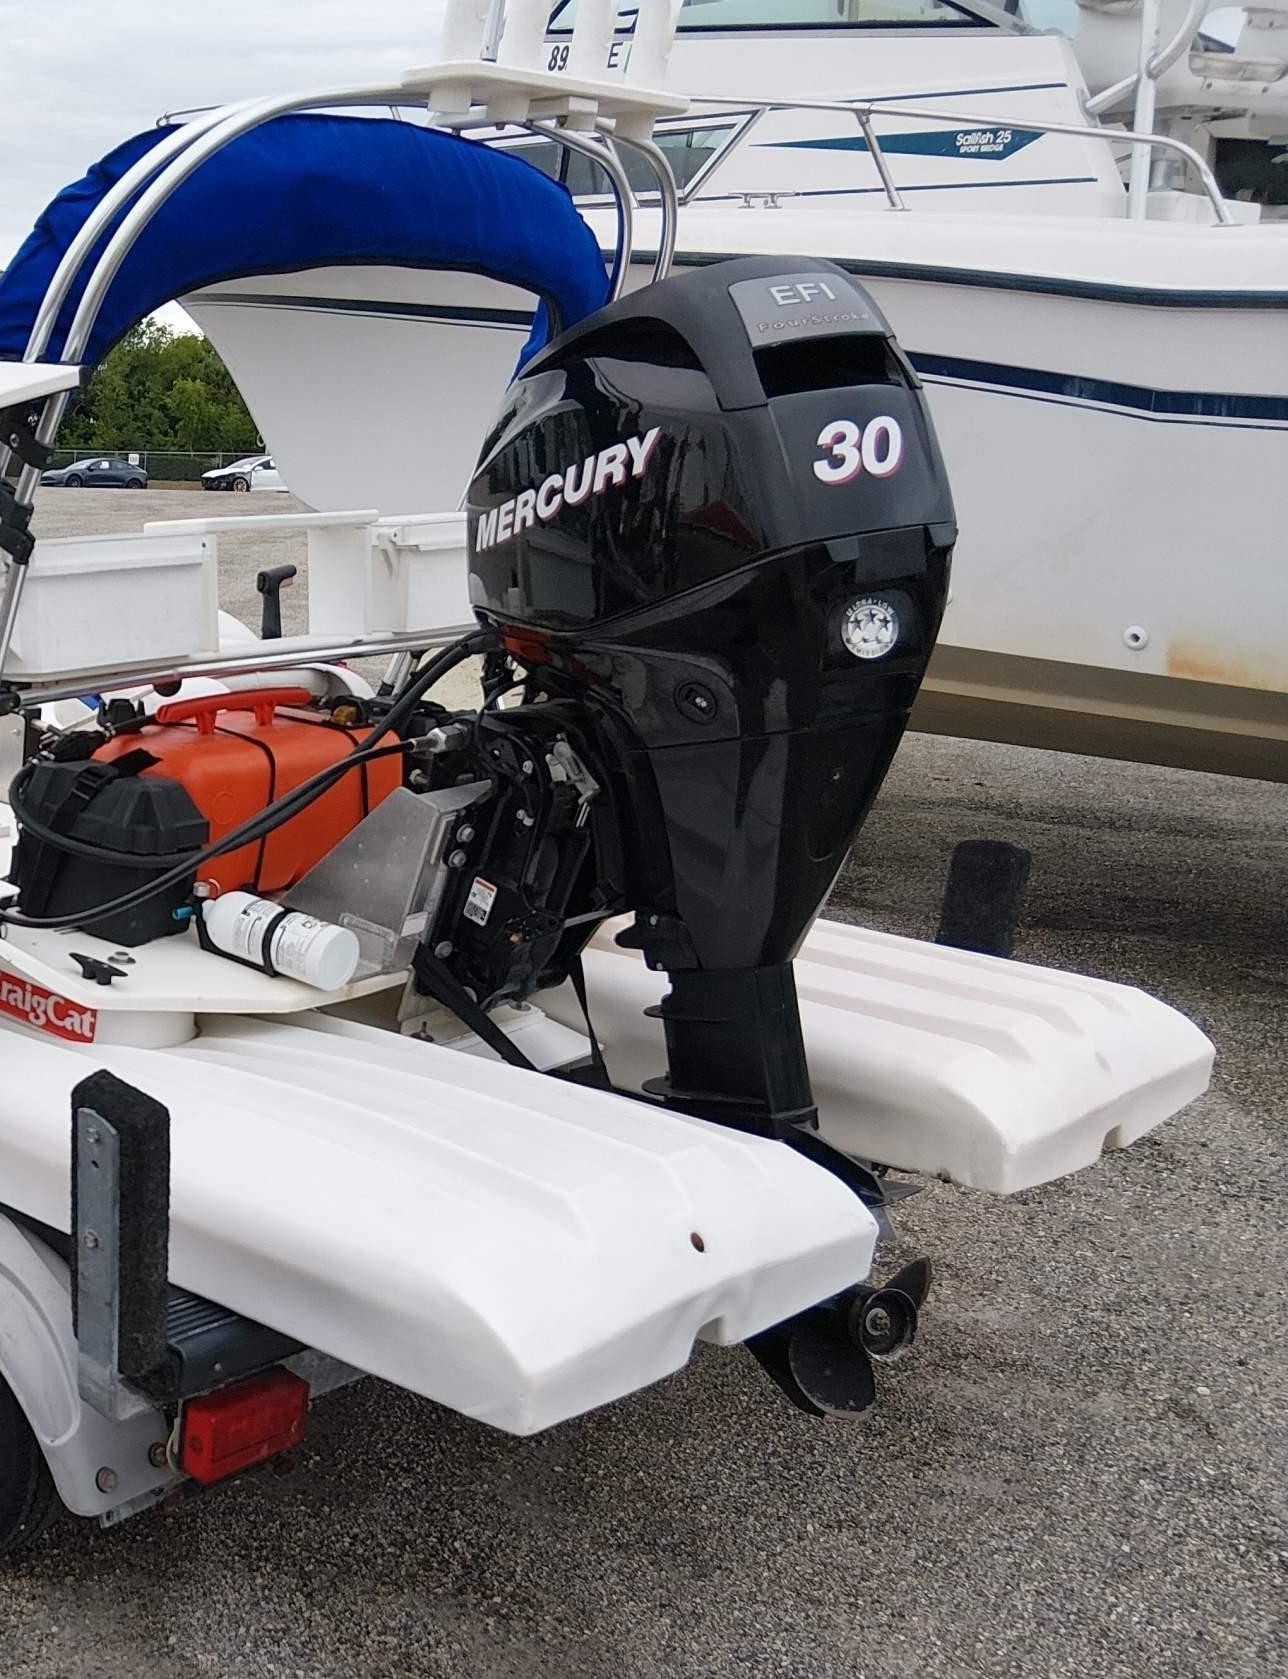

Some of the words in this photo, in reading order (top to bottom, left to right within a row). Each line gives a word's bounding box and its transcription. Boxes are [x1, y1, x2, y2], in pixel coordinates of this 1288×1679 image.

[547, 44, 570, 72] 89
[955, 131, 993, 146] Sailfish
[995, 130, 1013, 144] 25
[769, 281, 837, 306] EFI
[813, 416, 903, 486] 30
[475, 425, 663, 554] MERCURY
